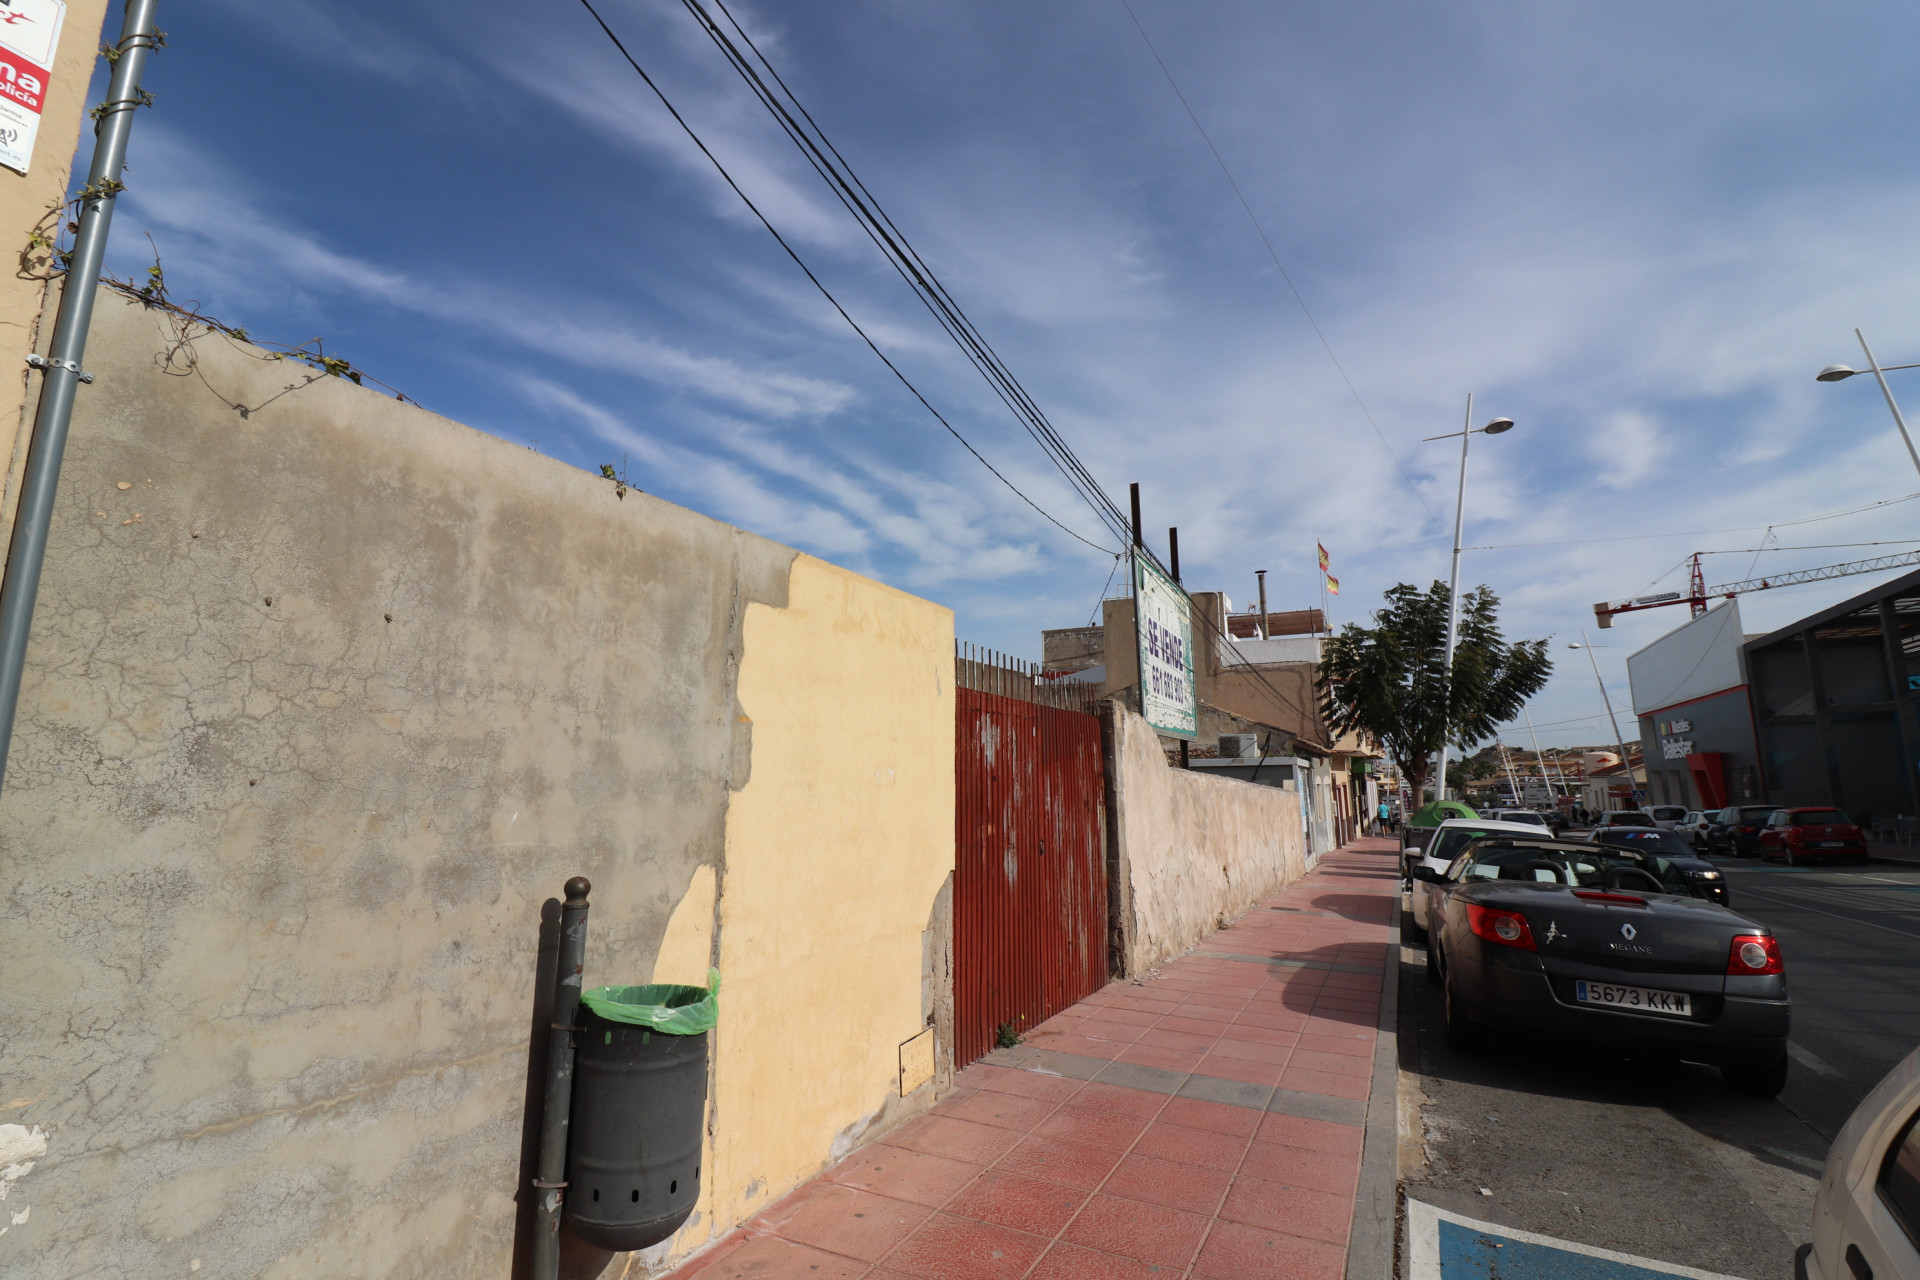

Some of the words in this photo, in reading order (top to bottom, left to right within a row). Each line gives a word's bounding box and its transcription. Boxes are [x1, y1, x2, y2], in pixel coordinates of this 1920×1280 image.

[1148, 617, 1159, 659] SE
[1159, 625, 1183, 672] VENDE
[1152, 665, 1163, 695] 661
[1610, 943, 1653, 955] MEGANE
[1590, 984, 1640, 1005] 5673
[1647, 991, 1684, 1012] KKW
